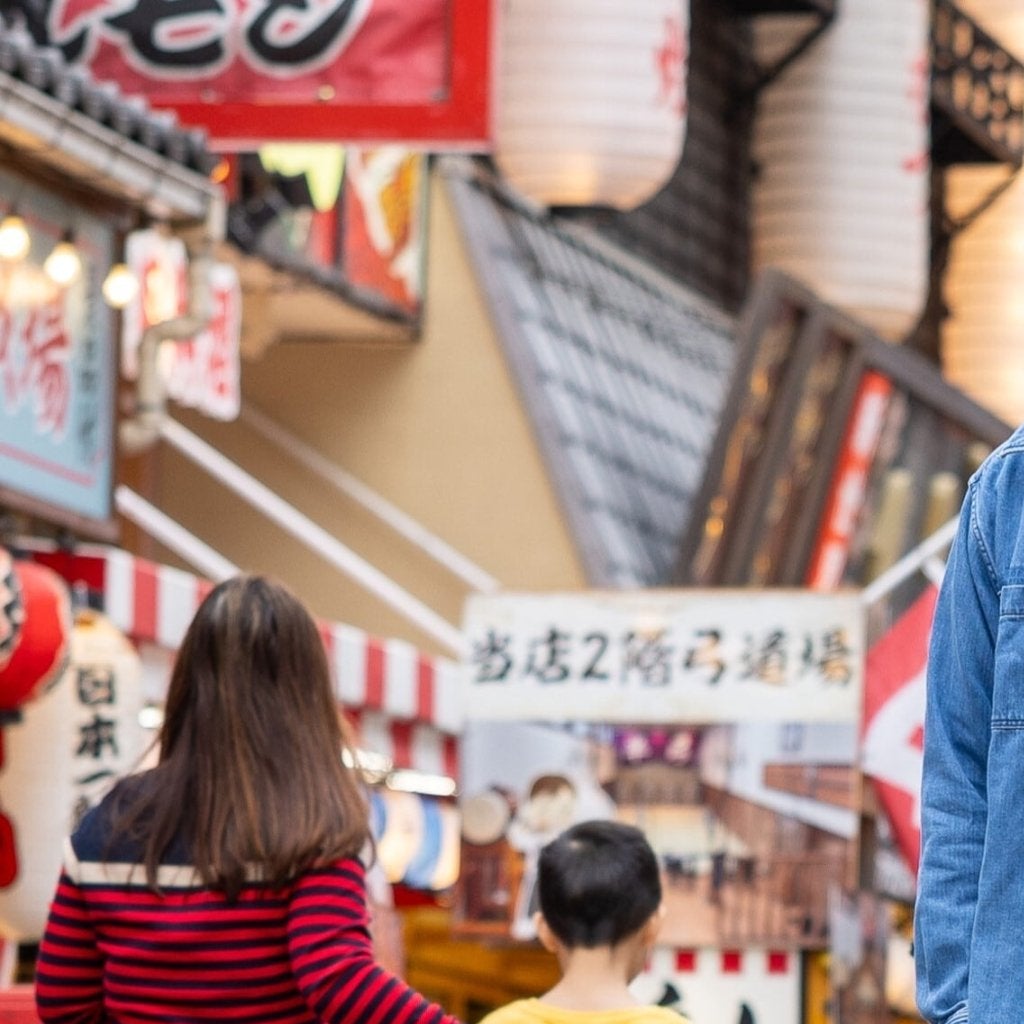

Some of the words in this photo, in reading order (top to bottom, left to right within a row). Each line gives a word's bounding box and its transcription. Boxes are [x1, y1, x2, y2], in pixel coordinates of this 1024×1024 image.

[472, 624, 852, 688] 当店2階弓道場
[74, 665, 120, 826] 日本一
